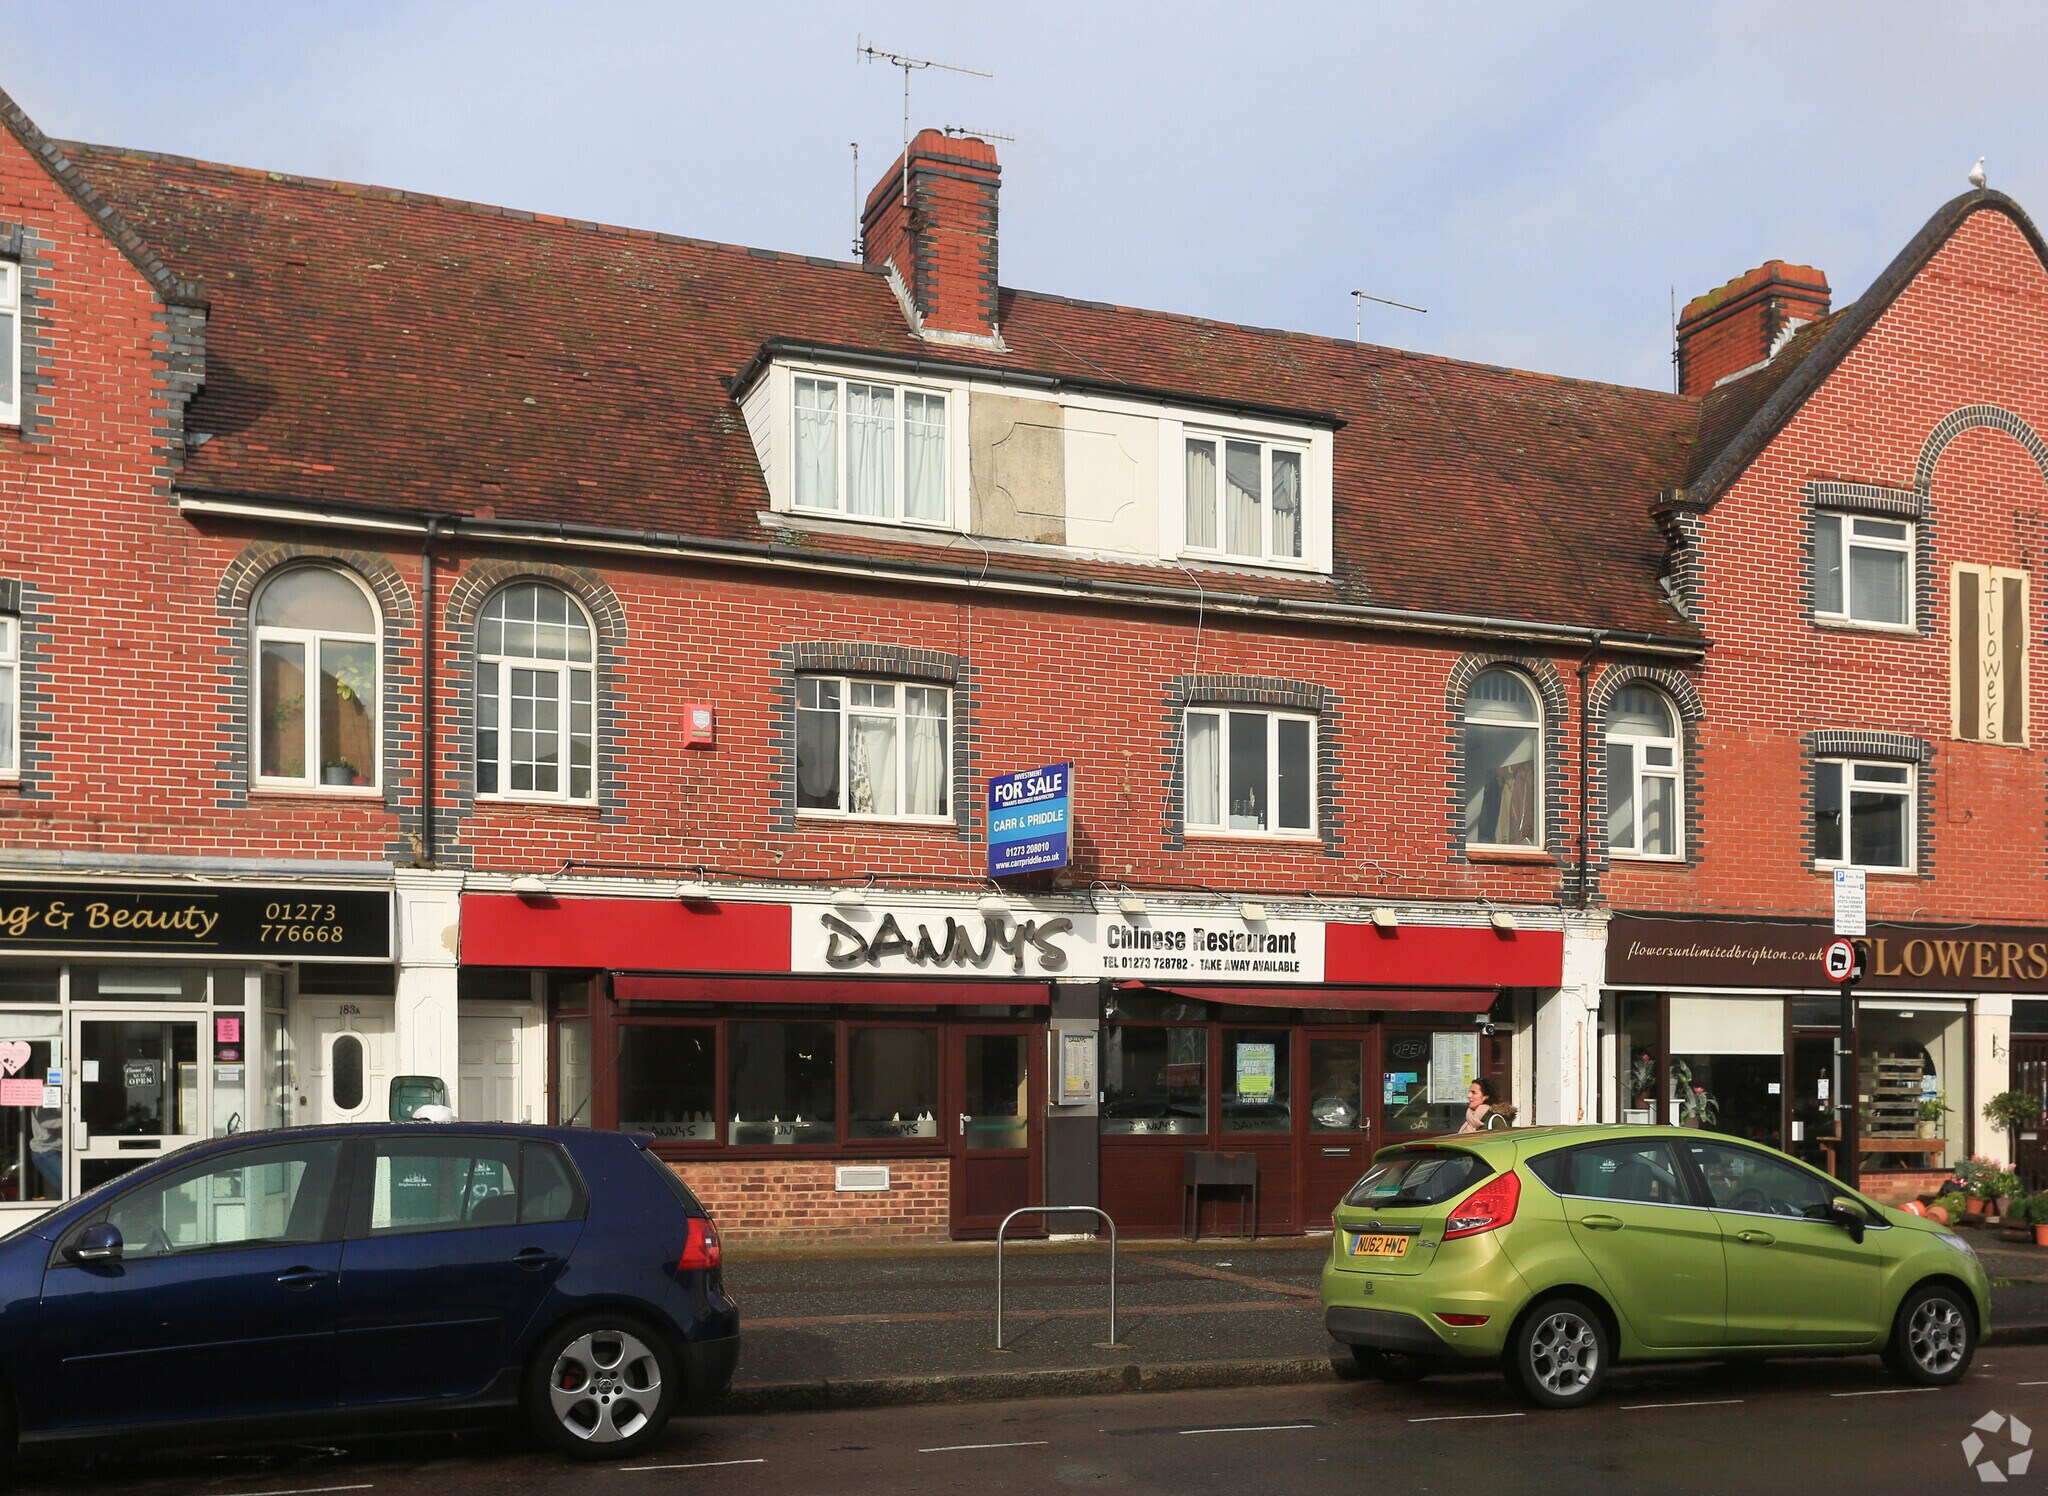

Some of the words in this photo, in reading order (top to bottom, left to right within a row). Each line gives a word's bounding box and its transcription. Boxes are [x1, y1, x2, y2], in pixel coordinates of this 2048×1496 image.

[1014, 769, 1043, 781] INVESTMENT
[995, 781, 1023, 802] FOR
[1026, 773, 1062, 797] SALE
[994, 818, 1017, 832] CARR
[1018, 816, 1026, 828] &
[1028, 809, 1064, 826] PRIDDLE
[1006, 846, 1024, 858] 01273
[0, 905, 40, 936] g
[44, 901, 75, 930] &
[86, 902, 218, 938] Beauty
[265, 902, 336, 922] 01273
[260, 924, 344, 943] 776668
[820, 912, 1074, 973] DANNY'S
[1107, 924, 1186, 950] Chinese
[1193, 928, 1296, 954] Restaurant
[1627, 941, 1824, 966] flowersunlimitedbrighton.co.uk
[1103, 956, 1119, 968] TEL
[1122, 956, 1150, 969] 01273
[1154, 957, 1188, 970] 728782
[1200, 958, 1222, 971] TAKE
[1224, 959, 1250, 972] AWAY
[1252, 960, 1300, 973] AVAILABLE
[1392, 1043, 1427, 1055] OPEN
[1356, 1237, 1383, 1252] NU62
[1384, 1238, 1407, 1253] HWC
